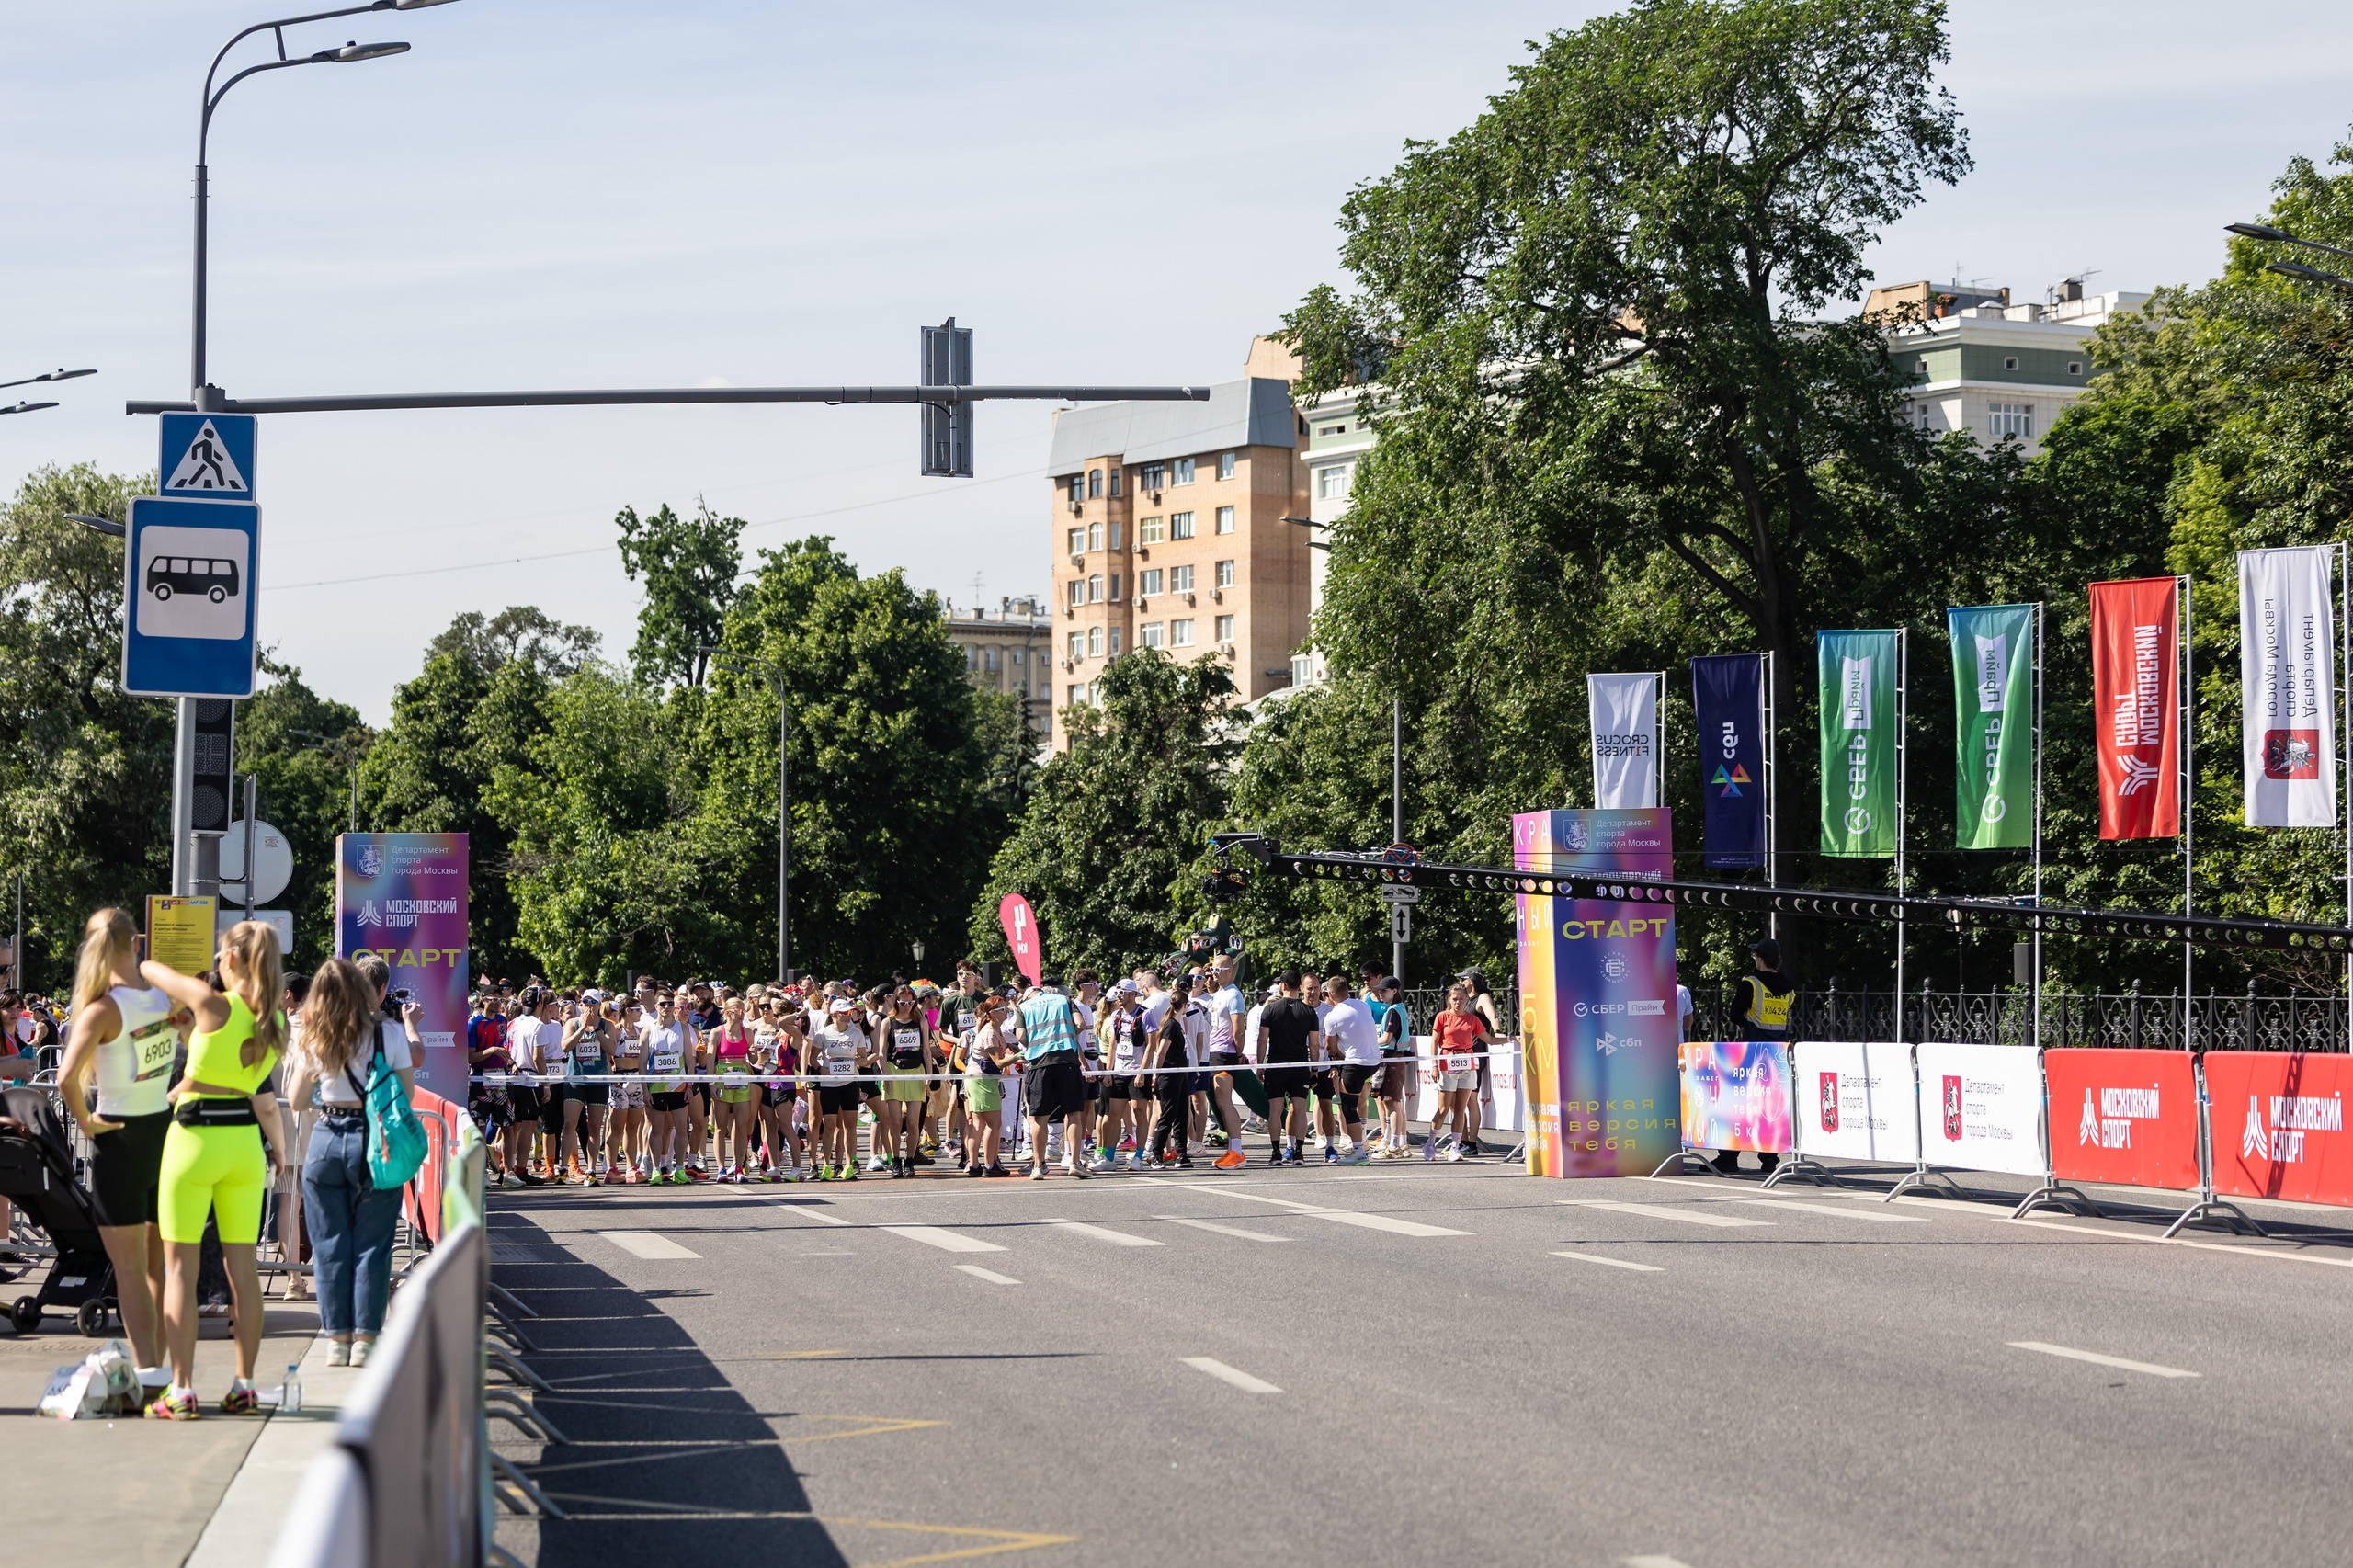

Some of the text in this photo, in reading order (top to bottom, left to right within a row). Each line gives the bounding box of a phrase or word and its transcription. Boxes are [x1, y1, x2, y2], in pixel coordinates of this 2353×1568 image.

[1597, 820, 1652, 828] Департамент
[1516, 819, 1549, 846] КРА
[1597, 830, 1625, 838] спорта
[392, 846, 449, 855] Департамент
[1597, 840, 1626, 848] города
[392, 856, 421, 865] спорта
[392, 867, 422, 876] города
[386, 897, 457, 914] МОСКОВСКИЙ
[386, 915, 419, 927] СПОРТ
[1563, 918, 1667, 940] СТАРТ
[1522, 993, 1537, 1034] 5
[1592, 1004, 1658, 1014] СБЕР Прайм
[421, 1035, 449, 1044] Прайм
[899, 1036, 916, 1044] 6569
[1620, 1038, 1642, 1047] сбп
[144, 1039, 172, 1064] 6903
[1119, 1044, 1128, 1052] 92
[658, 1058, 676, 1066] 3886
[1523, 1038, 1557, 1076] КМ
[414, 1069, 430, 1079] бп
[1417, 1070, 1433, 1085] mos.
[1733, 1067, 1763, 1080] яркая
[1492, 1073, 1517, 1090] mos.ru
[1842, 1074, 1881, 1091] Департамент
[1965, 1079, 2004, 1096] Департамент
[1733, 1086, 1770, 1098] версия
[1568, 1099, 1654, 1114] яркая
[1842, 1097, 1863, 1111] спорта
[2101, 1083, 2159, 1119] МОСКОВСКИЙ
[1734, 1103, 1757, 1115] тебя
[1966, 1104, 1986, 1119] спорта
[2270, 1091, 2343, 1131] МОСКОВСКИЙ
[1569, 1118, 1677, 1133] версия
[1734, 1123, 1740, 1136] 5
[1843, 1116, 1888, 1131] города Москвы
[1967, 1124, 2013, 1140] города Москвы
[2101, 1120, 2131, 1149] СПОРТ
[1569, 1136, 1636, 1151] тебя
[2271, 1131, 2305, 1164] СПОРТ
